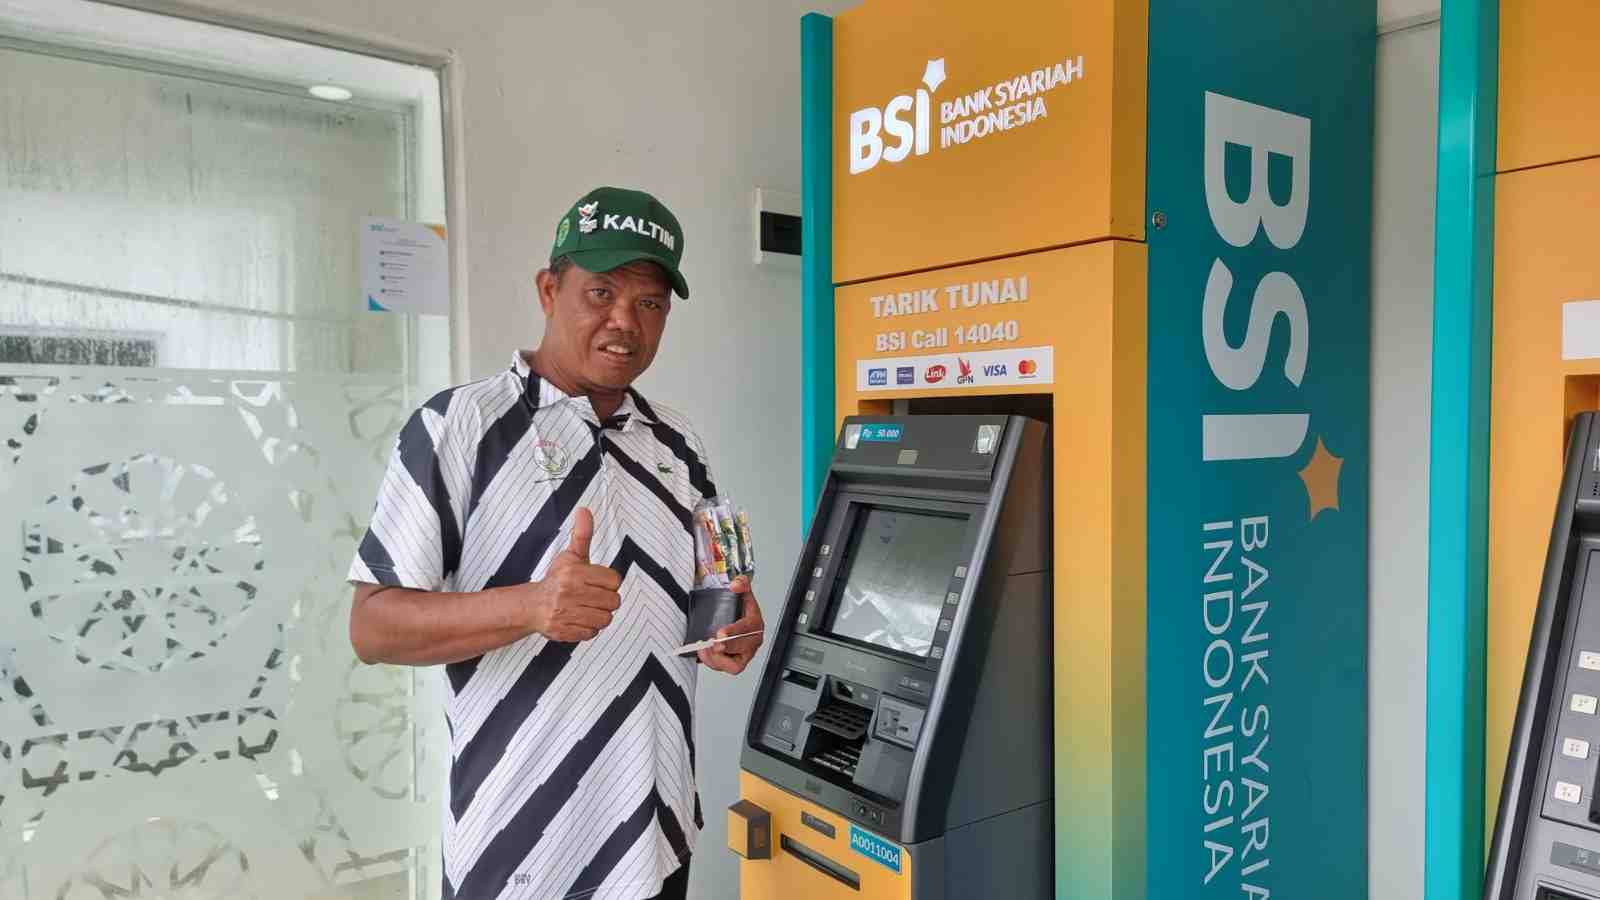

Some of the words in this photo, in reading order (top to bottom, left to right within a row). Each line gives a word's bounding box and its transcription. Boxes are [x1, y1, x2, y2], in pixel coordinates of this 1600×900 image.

[940, 86, 993, 123] BANK
[995, 55, 1083, 106] SYARIAH
[849, 88, 930, 175] BSI
[940, 97, 1047, 149] INDONESIA
[602, 213, 675, 251] KALTIM
[870, 287, 939, 318] TARIK
[946, 275, 1028, 310] TUNAI
[1202, 90, 1312, 462] BSI
[875, 331, 906, 352] BSI
[911, 327, 948, 349] Call
[954, 320, 1018, 344] 14040
[983, 364, 1008, 377] VISA
[1240, 515, 1269, 692] BANK
[1203, 520, 1234, 885] INDONESIA
[852, 833, 899, 865] A0011004
